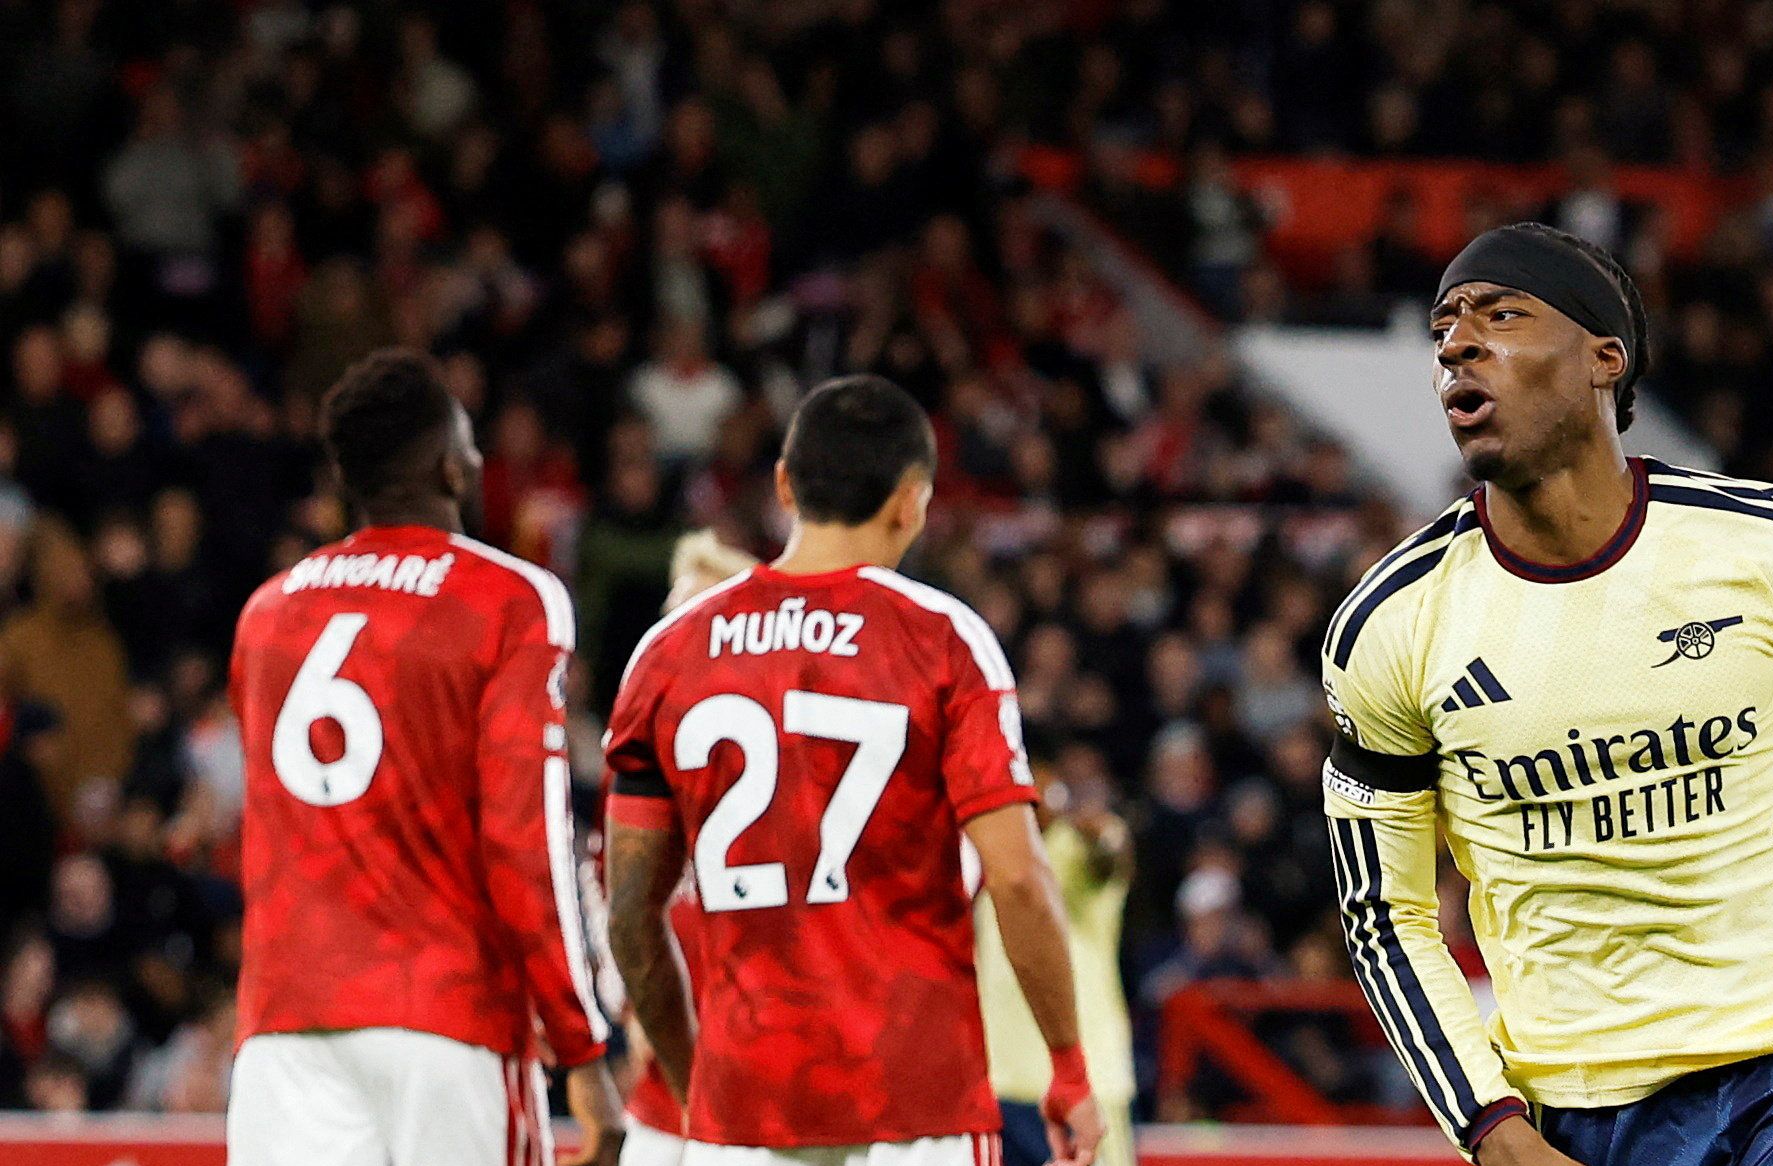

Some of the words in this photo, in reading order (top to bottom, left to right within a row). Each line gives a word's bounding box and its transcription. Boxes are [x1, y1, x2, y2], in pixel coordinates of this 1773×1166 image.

[708, 596, 865, 659] MUÑOZ
[272, 612, 384, 807] 6
[1453, 706, 1757, 800] Emirates
[673, 689, 911, 912] 27
[1520, 801, 1573, 851] FLY
[1592, 766, 1725, 843] BETTER
